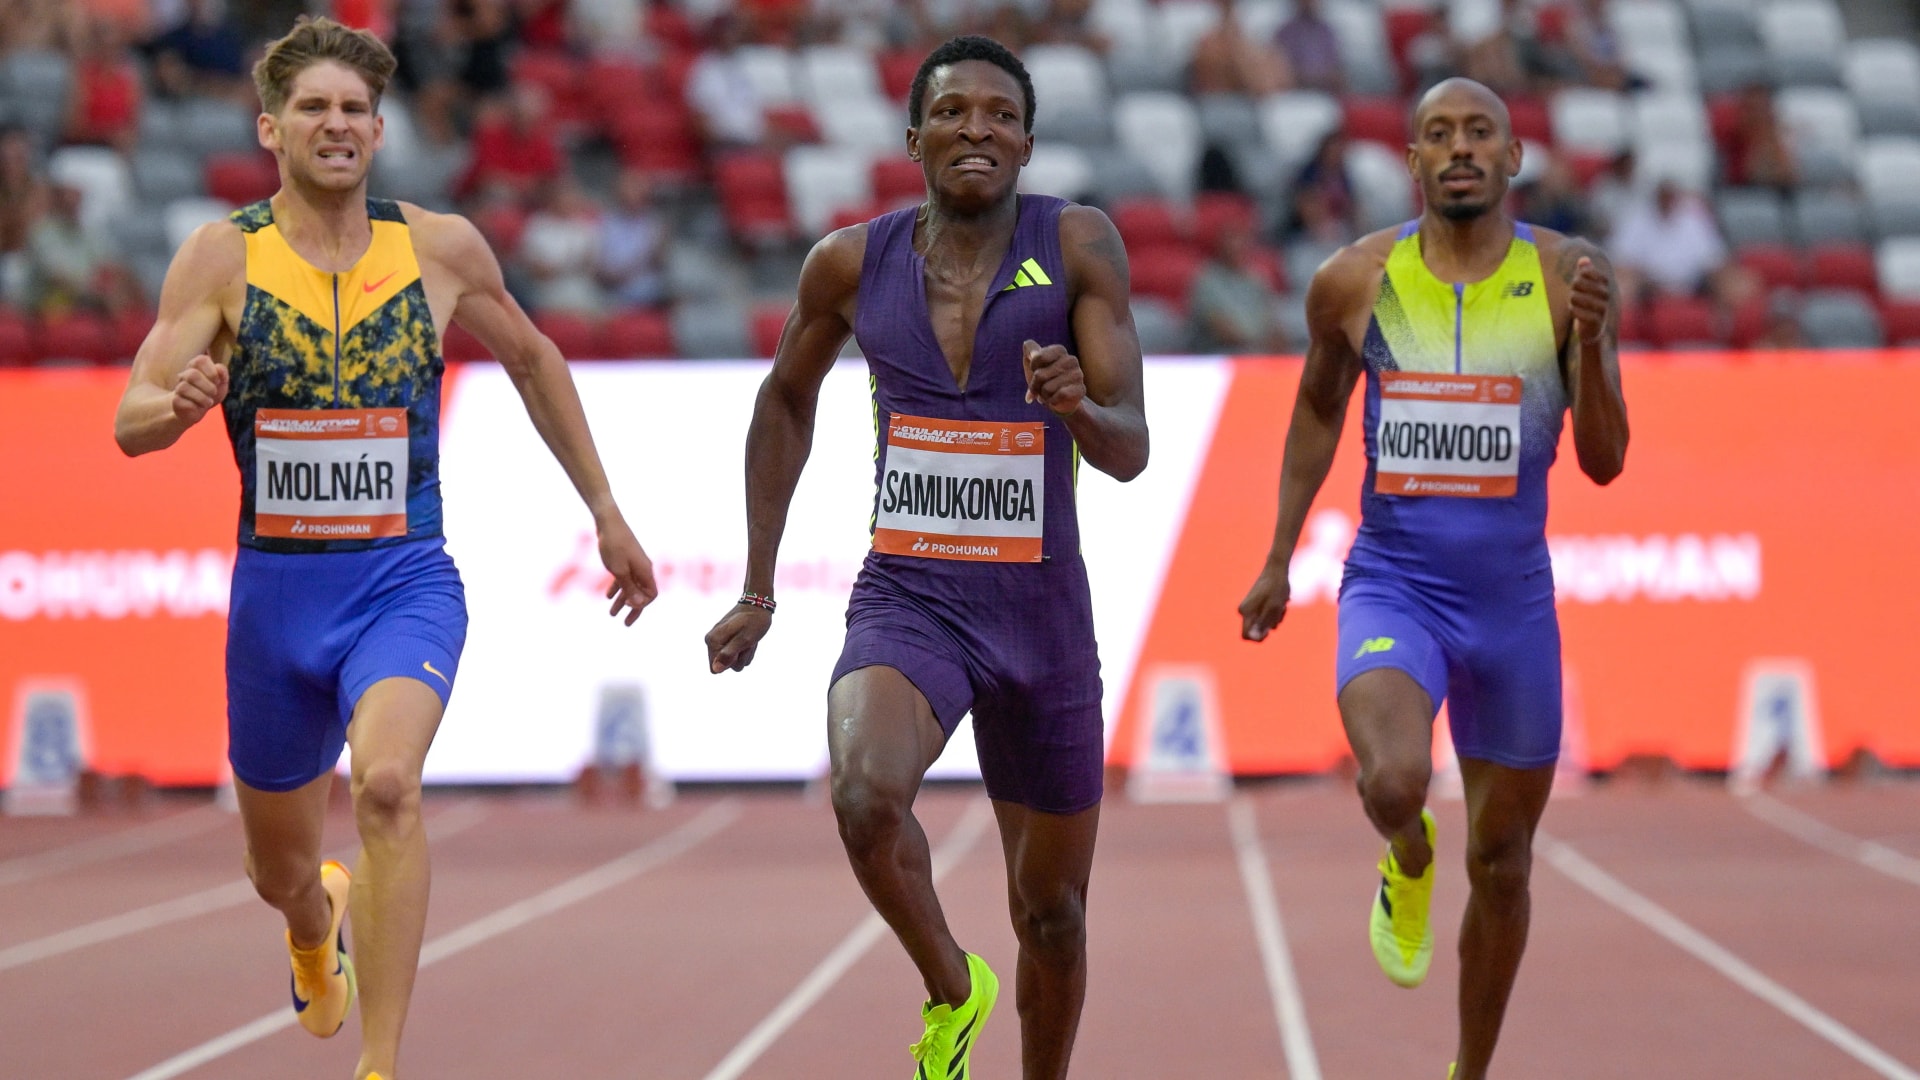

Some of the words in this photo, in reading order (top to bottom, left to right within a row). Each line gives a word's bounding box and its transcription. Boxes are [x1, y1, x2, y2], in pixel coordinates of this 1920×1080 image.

[893, 430, 955, 444] MEMORIAL
[901, 425, 943, 437] GYULAI
[1382, 421, 1512, 462] NORWOOD
[267, 453, 393, 501] MOLNÁR
[882, 469, 1036, 522] SAMUKONGA
[308, 524, 371, 534] PROHUMAN
[931, 543, 998, 556] PROHUMAN
